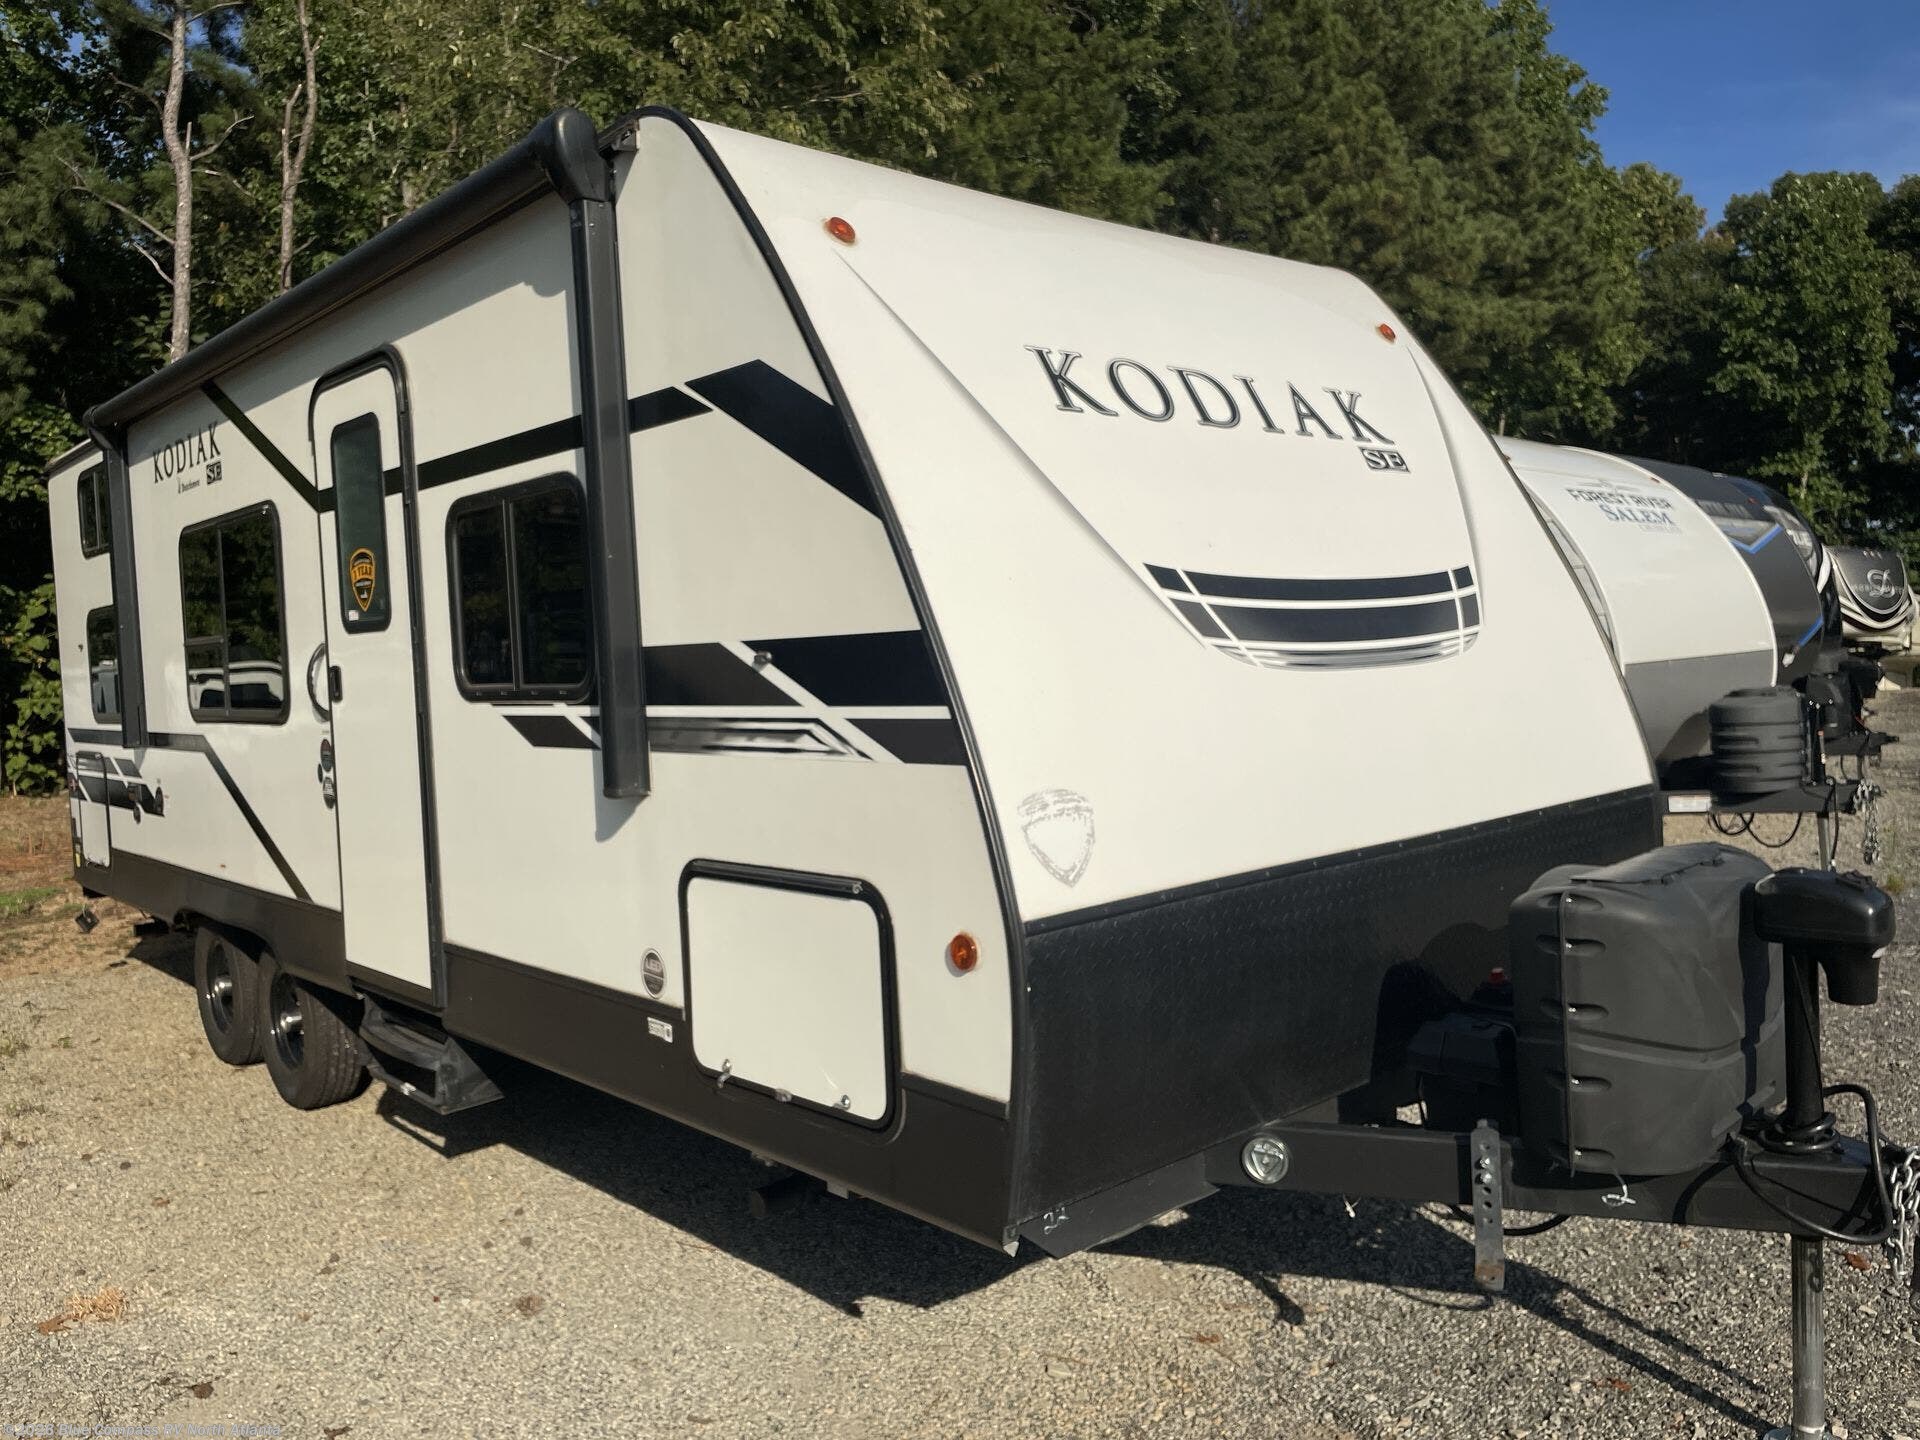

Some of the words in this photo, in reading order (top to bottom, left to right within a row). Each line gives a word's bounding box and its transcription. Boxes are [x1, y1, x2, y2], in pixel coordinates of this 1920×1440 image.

[1025, 345, 1394, 445] KODIAK
[153, 421, 220, 483] KODIAK
[1361, 449, 1408, 470] SE
[207, 462, 222, 484] SE
[1599, 504, 1676, 525] SALEM
